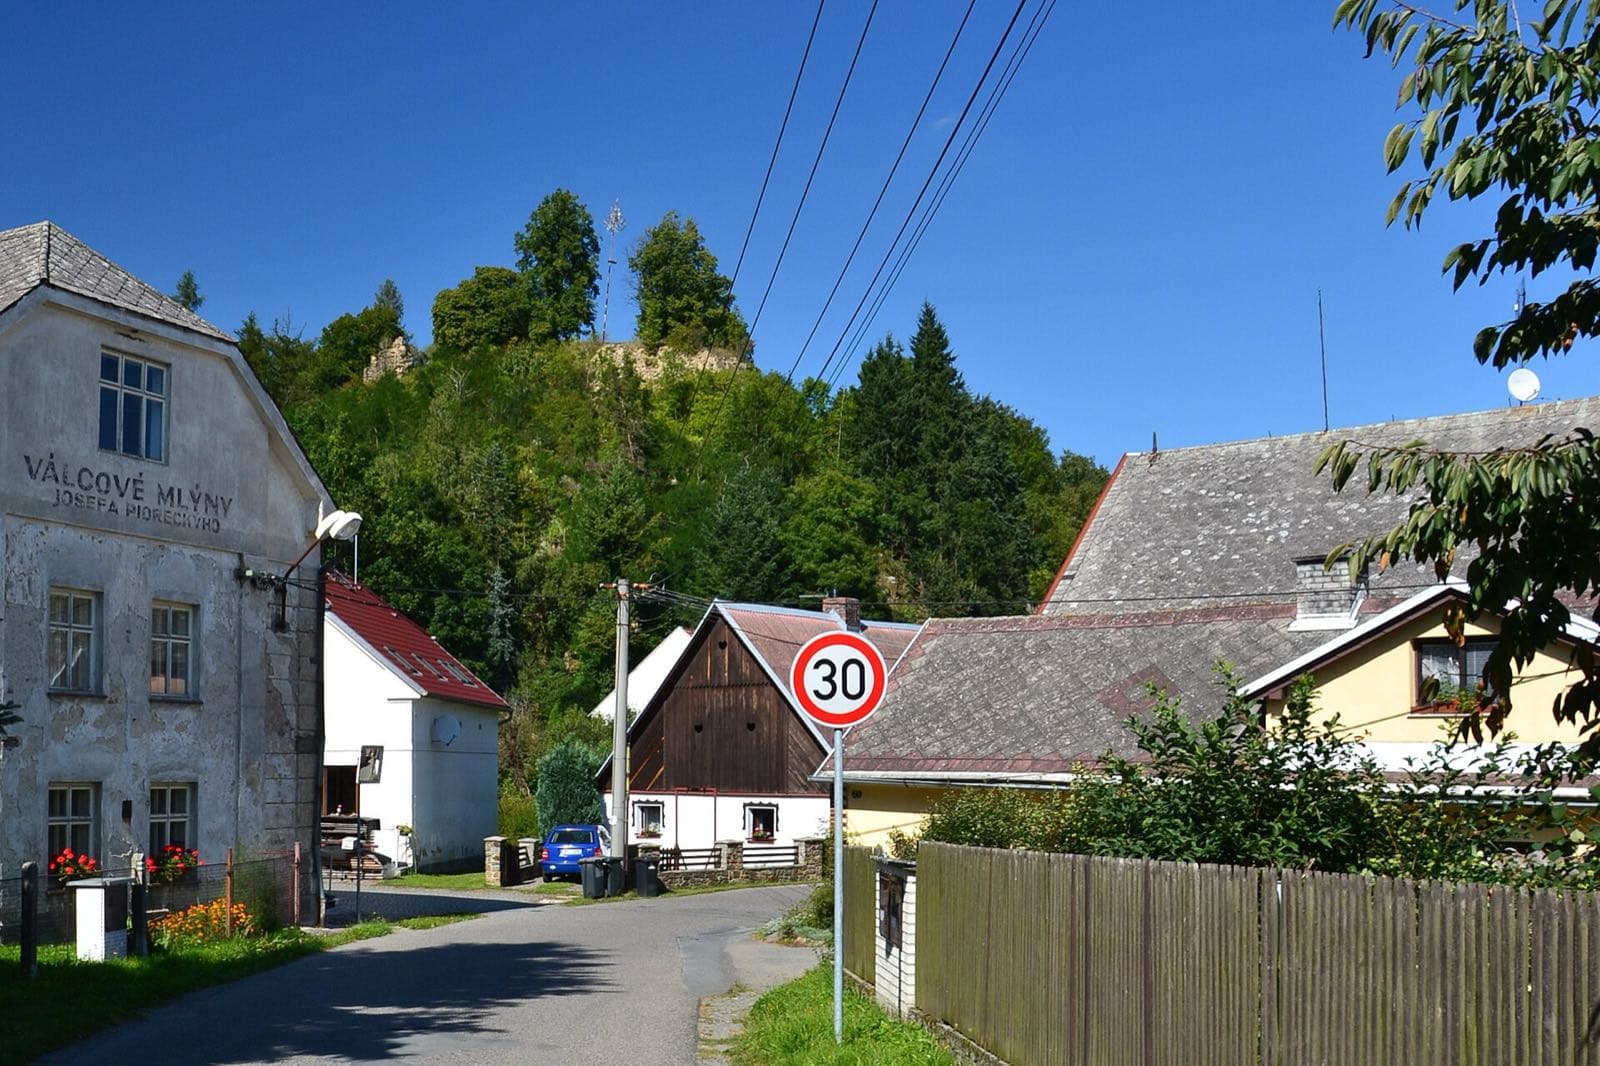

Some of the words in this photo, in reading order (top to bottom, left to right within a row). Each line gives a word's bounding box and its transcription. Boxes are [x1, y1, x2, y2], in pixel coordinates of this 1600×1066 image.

[23, 452, 145, 501] VÁLCOVÉ
[157, 483, 233, 518] MLÝNY
[52, 489, 119, 515] JOSEFA
[813, 658, 865, 701] 30
